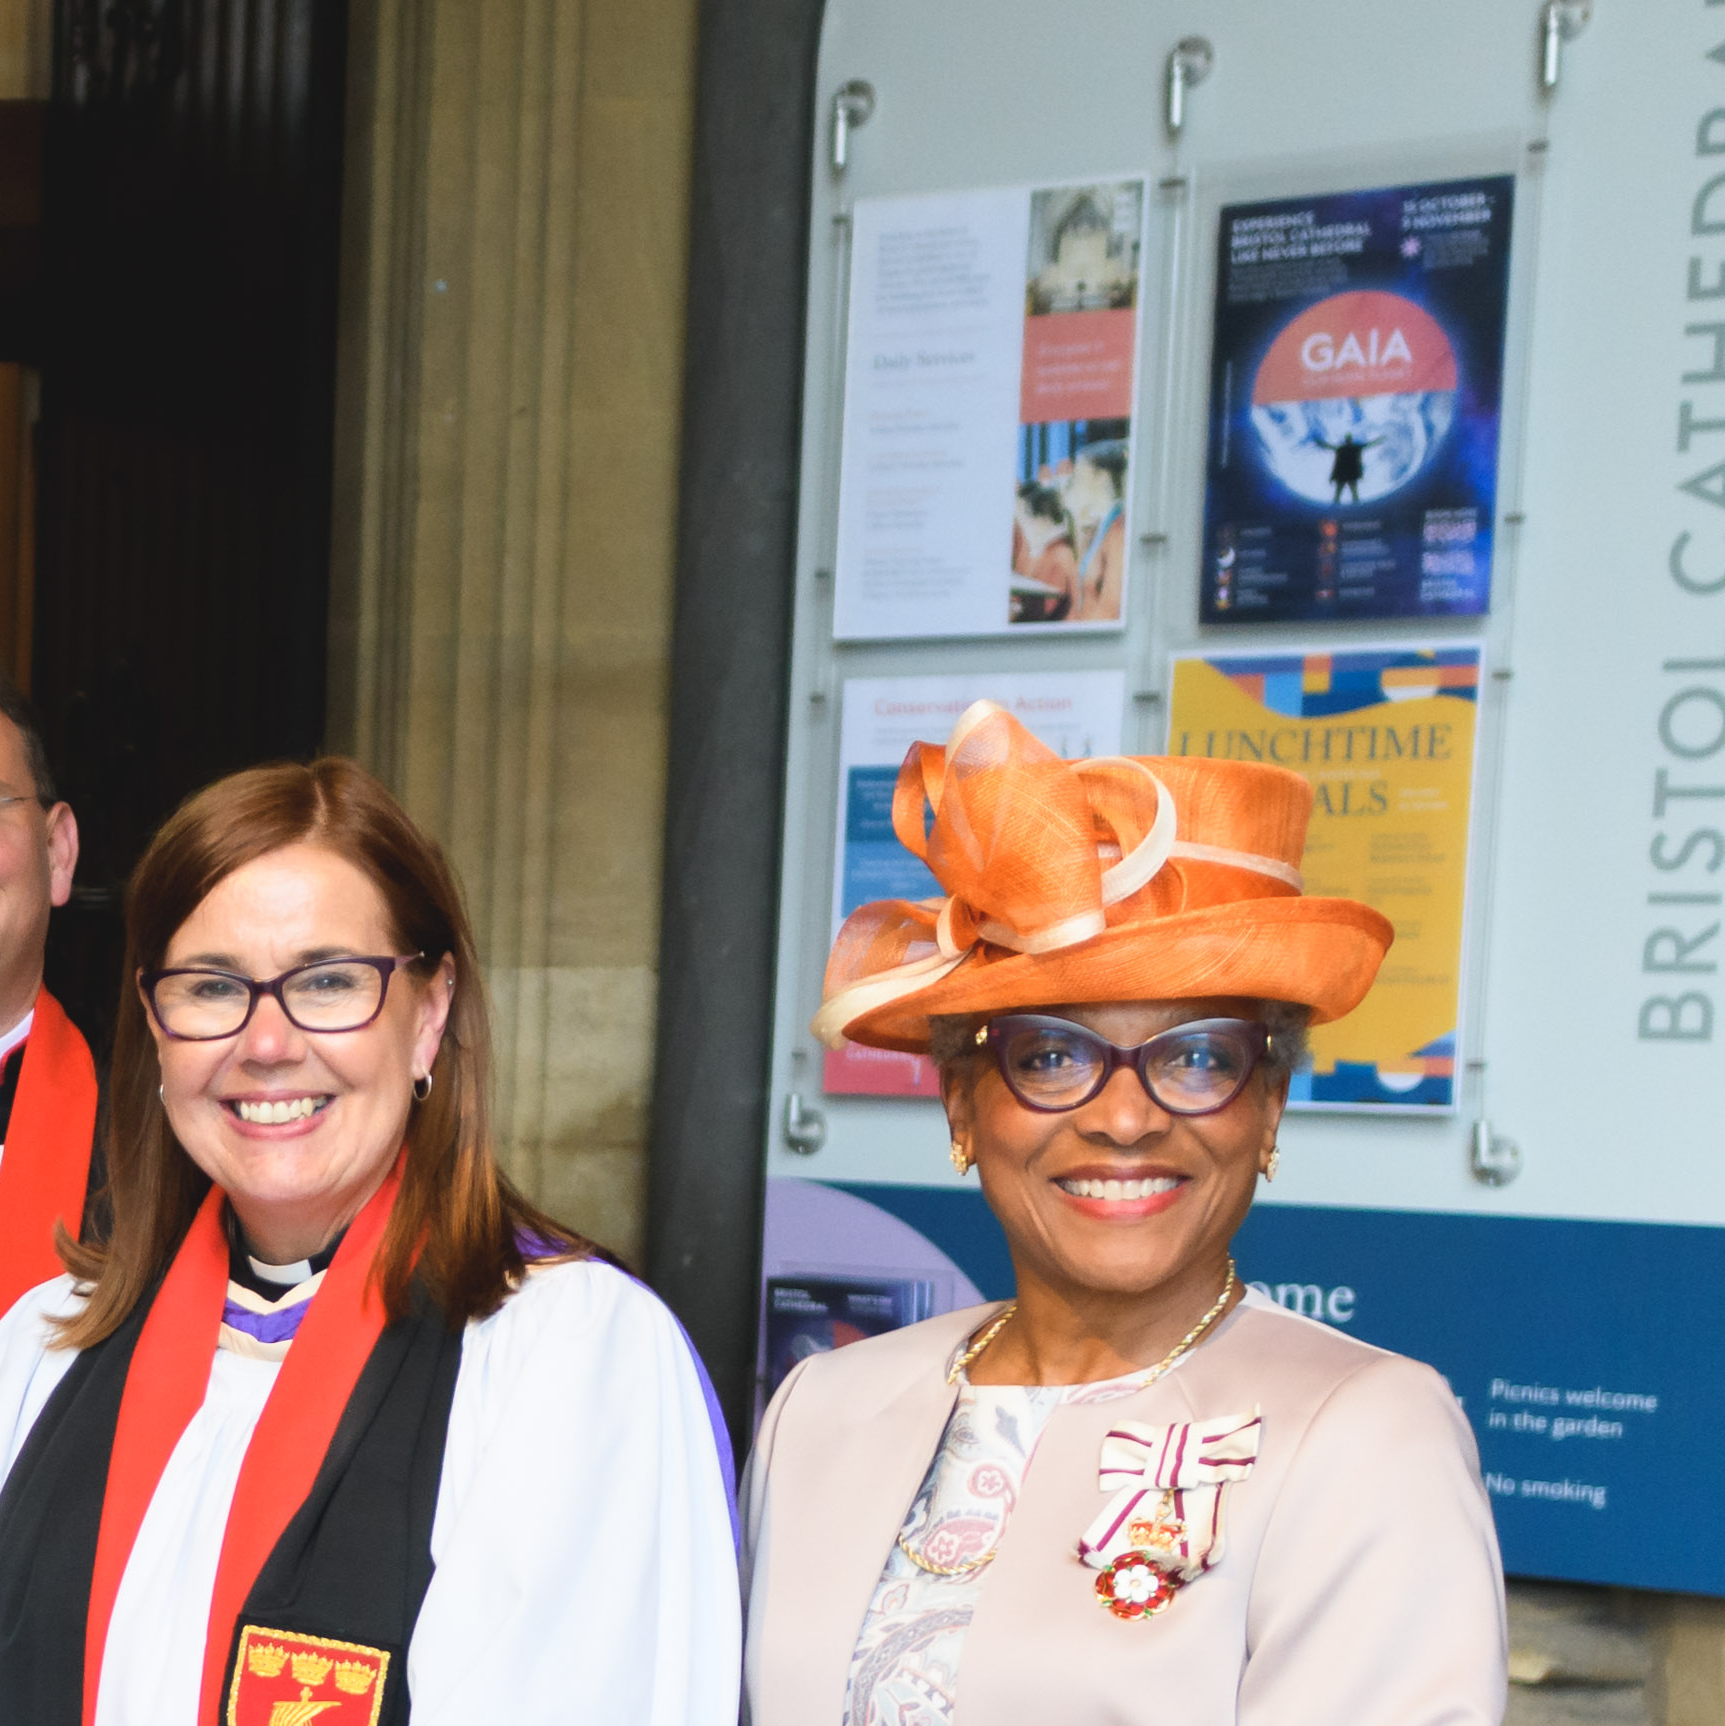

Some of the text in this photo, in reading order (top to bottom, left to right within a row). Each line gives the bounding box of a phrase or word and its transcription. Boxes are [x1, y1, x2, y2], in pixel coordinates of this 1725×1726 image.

[1231, 221, 1372, 248] BRISTOL CATHEDRAL
[1232, 211, 1314, 234] EXPERIENCE
[1413, 209, 1491, 230] NOVEMBER
[1262, 244, 1307, 262] NEVER
[1310, 239, 1364, 258] BEFORE
[1301, 327, 1413, 372] GAIA
[1180, 722, 1452, 762] LUNCHTIME
[1311, 779, 1389, 819] ALS
[1492, 1378, 1560, 1405] Picnics
[1565, 1386, 1658, 1413] welcome
[1488, 1408, 1623, 1440] in the garden
[1485, 1473, 1607, 1510] No smoking
